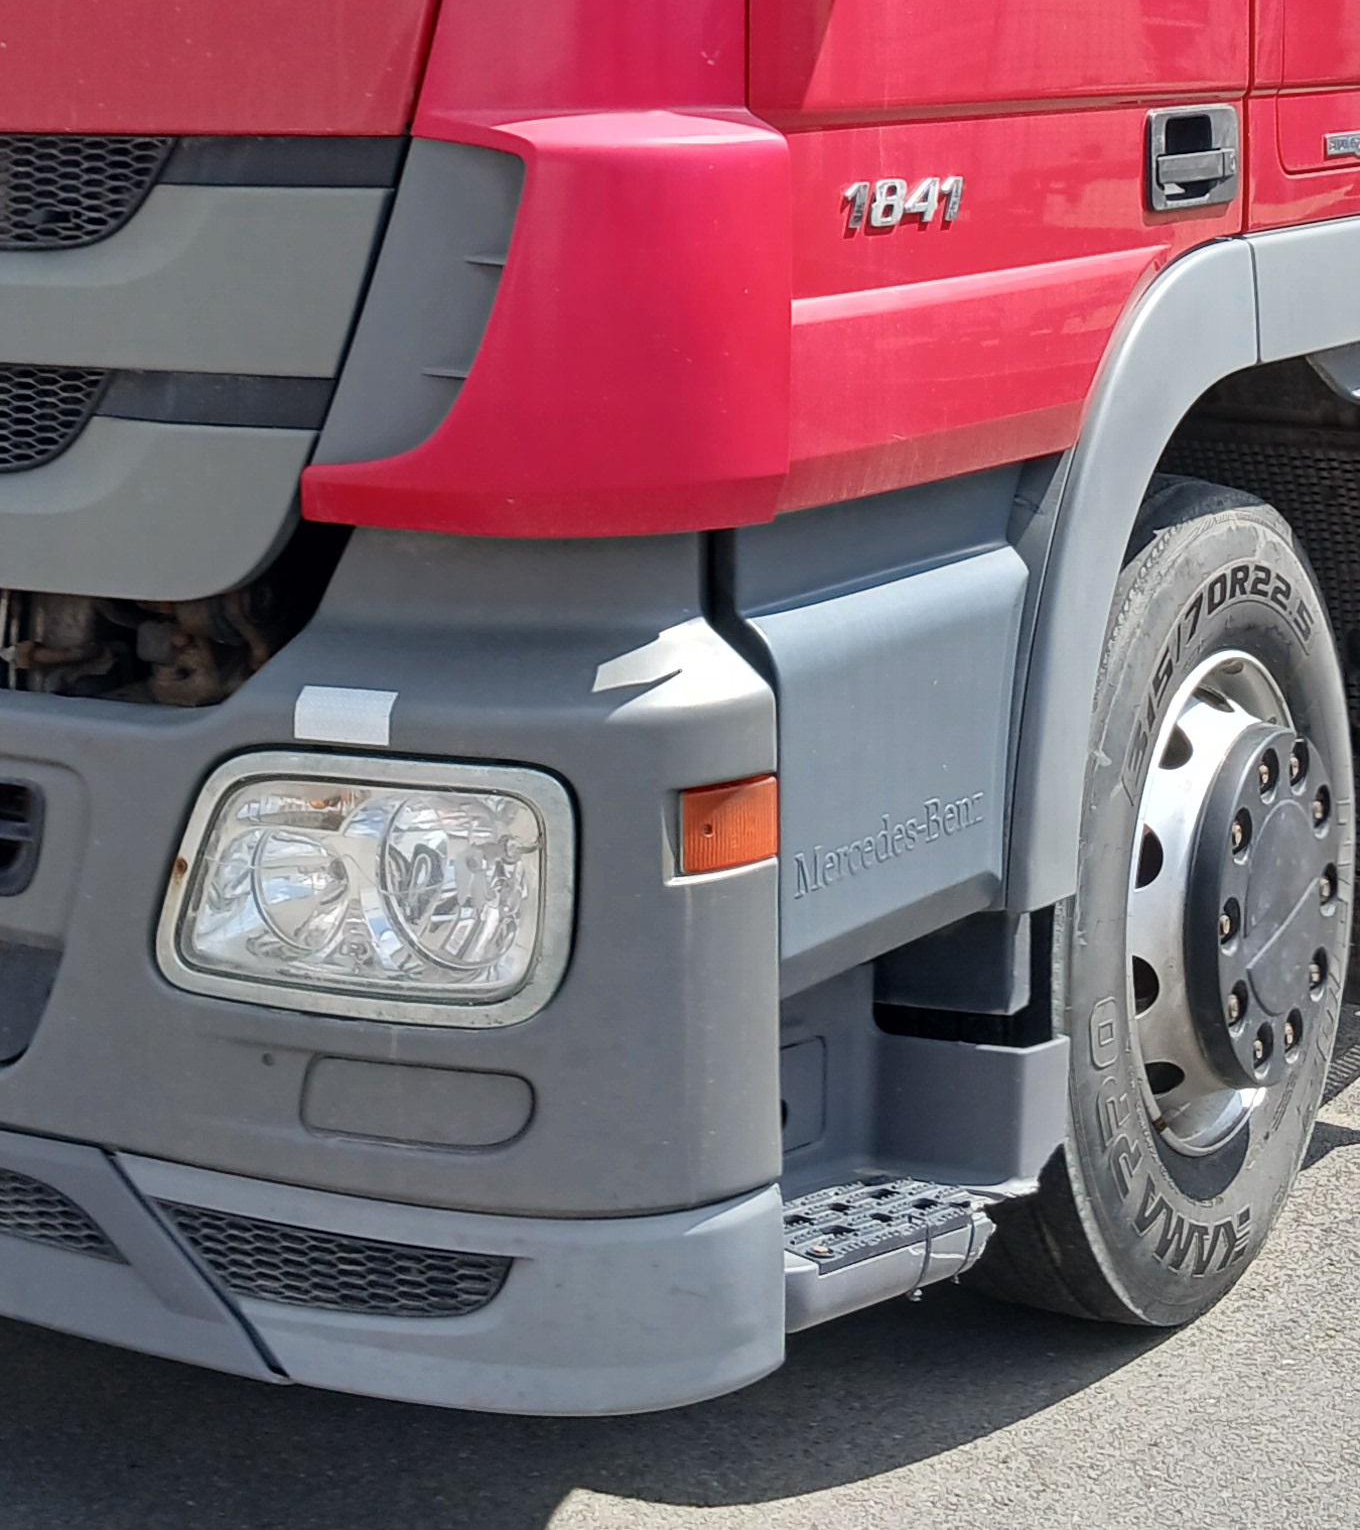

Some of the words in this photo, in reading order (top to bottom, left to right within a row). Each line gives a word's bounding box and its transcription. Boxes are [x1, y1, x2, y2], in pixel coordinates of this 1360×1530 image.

[844, 176, 964, 230] 1841
[1127, 564, 1317, 787] 315/70R22.5
[793, 789, 985, 900] Mercedes-Benz
